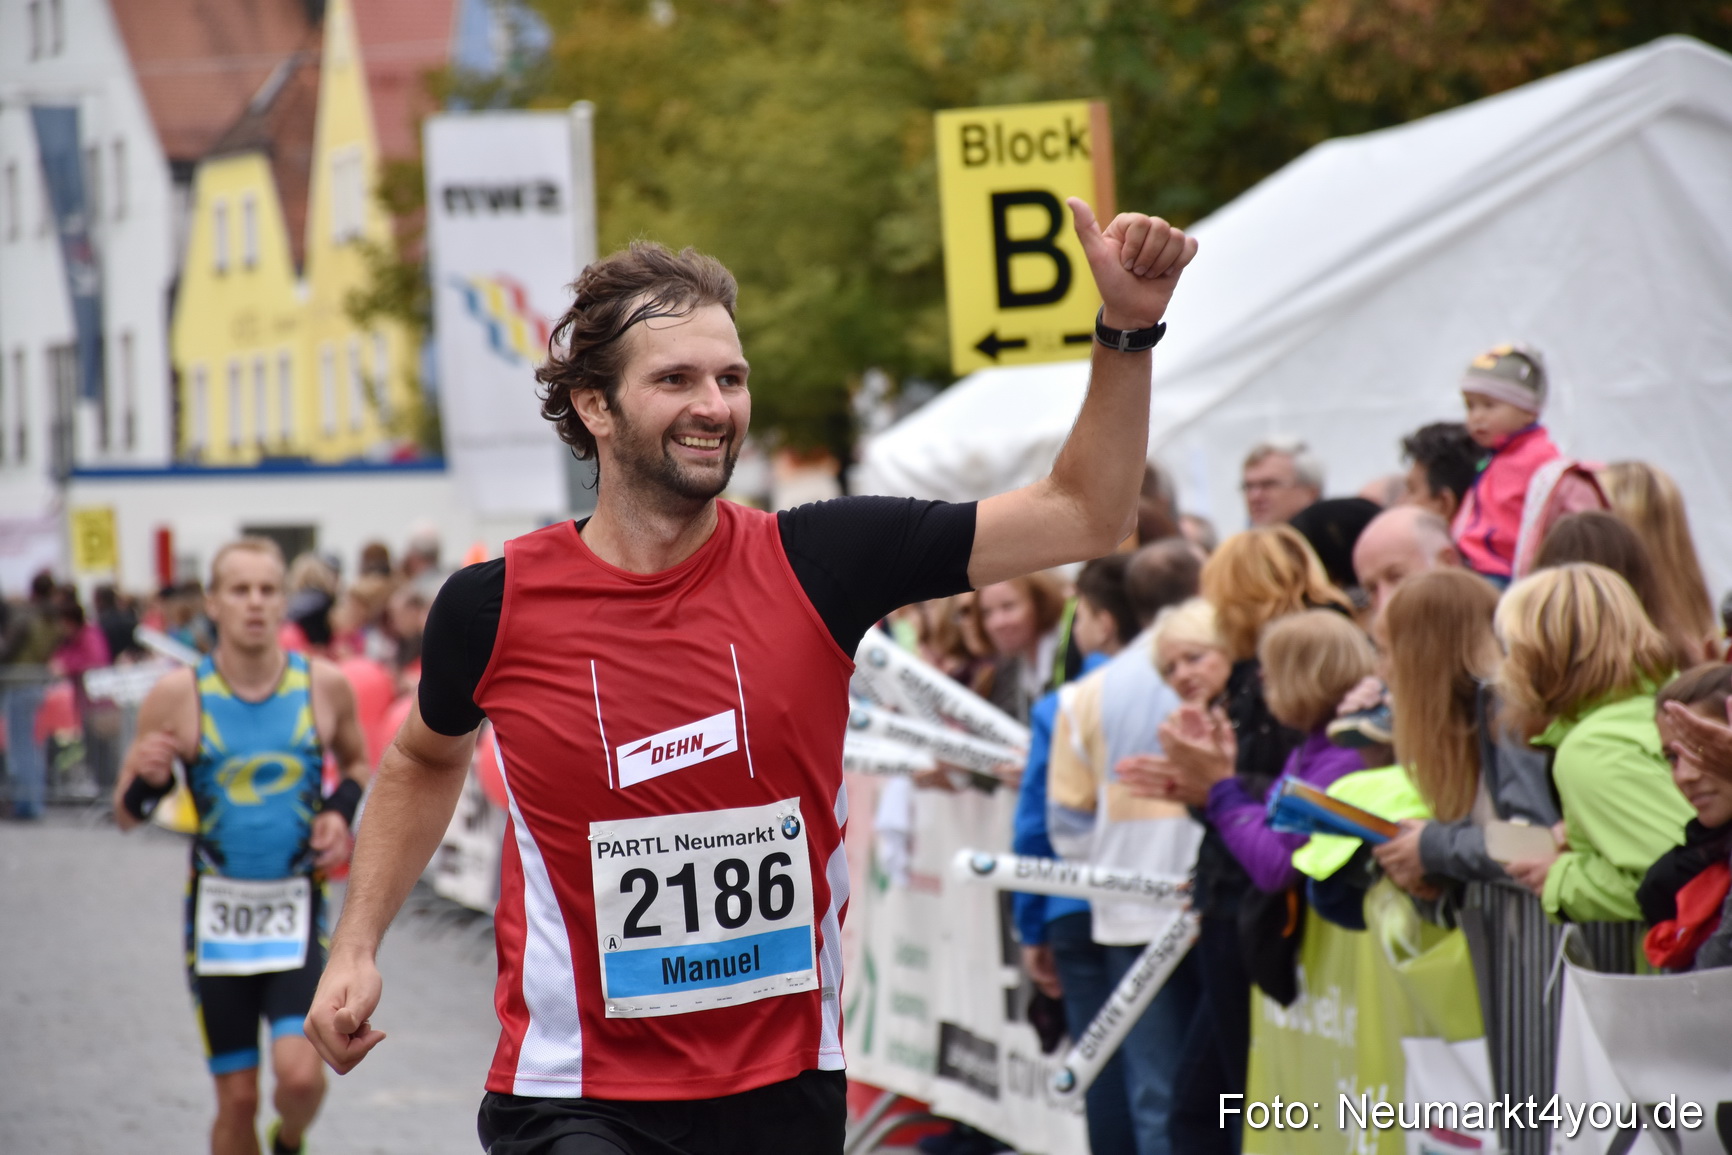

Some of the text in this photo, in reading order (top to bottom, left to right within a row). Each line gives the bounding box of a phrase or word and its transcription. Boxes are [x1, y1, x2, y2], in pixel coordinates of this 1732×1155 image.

[959, 117, 1090, 168] Block
[989, 189, 1073, 311] B
[651, 733, 704, 765] DEHN
[597, 826, 775, 859] PARTL Neumarkt
[1015, 862, 1079, 885] BMW
[619, 851, 795, 939] 2186
[210, 901, 296, 936] 3023
[608, 936, 618, 950] A
[661, 944, 760, 985] Manuel
[1081, 1004, 1123, 1060] BMW
